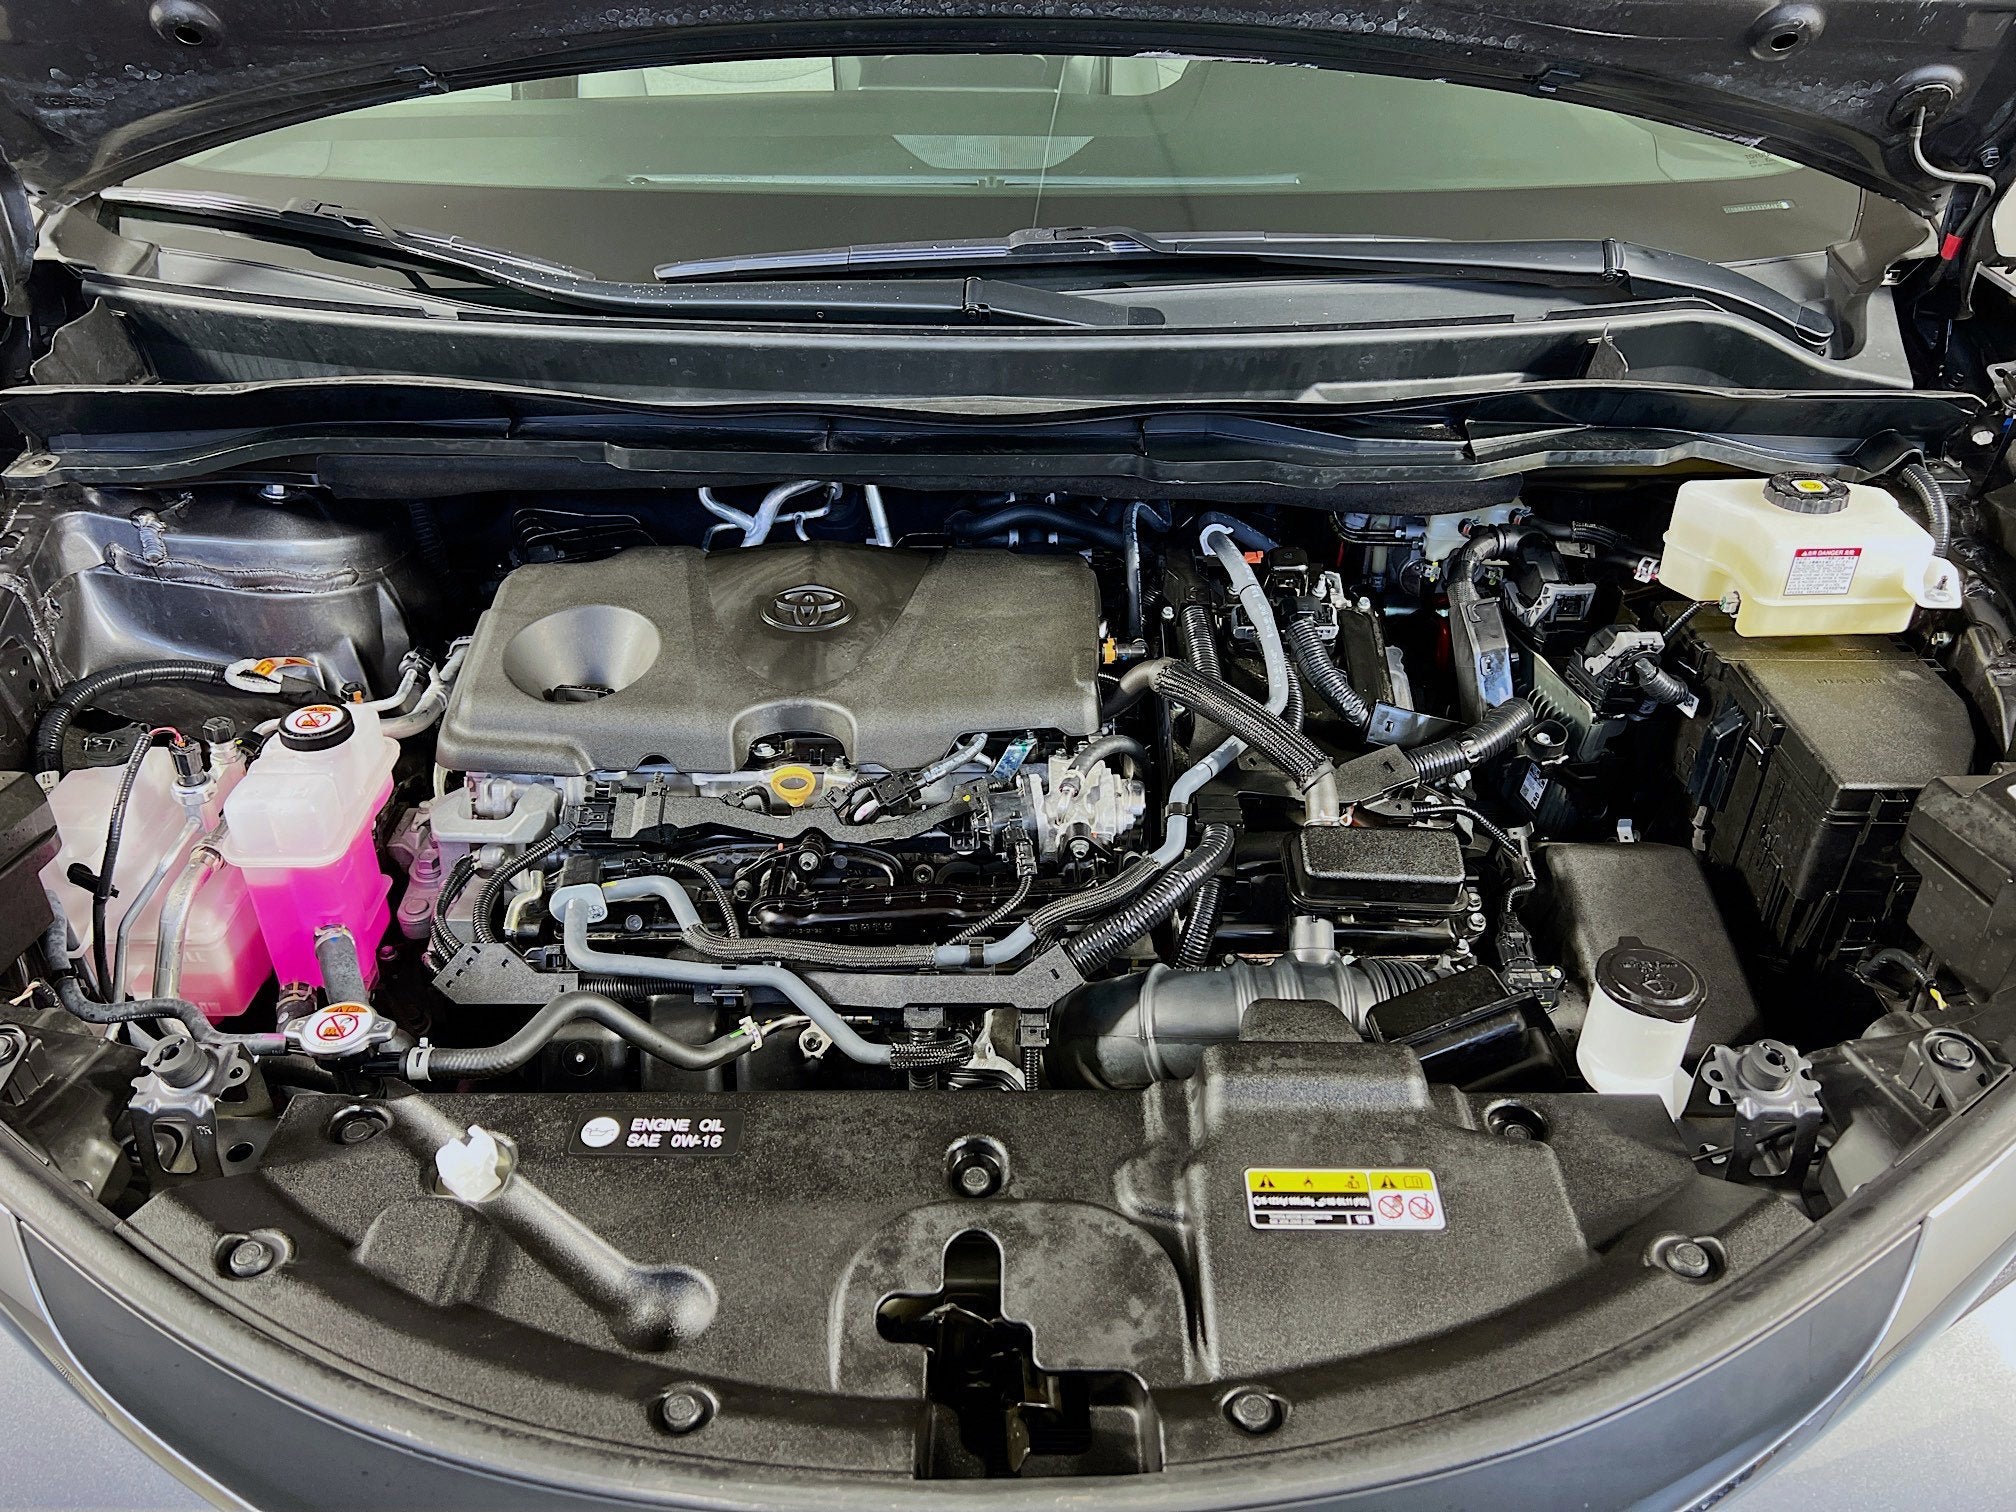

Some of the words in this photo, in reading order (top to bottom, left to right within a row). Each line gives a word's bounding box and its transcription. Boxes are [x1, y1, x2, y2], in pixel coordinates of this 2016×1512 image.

[630, 1118, 691, 1132] ENGINE
[698, 1118, 726, 1132] OIL
[626, 1133, 662, 1148] SAE
[670, 1134, 723, 1148] 0W-16
